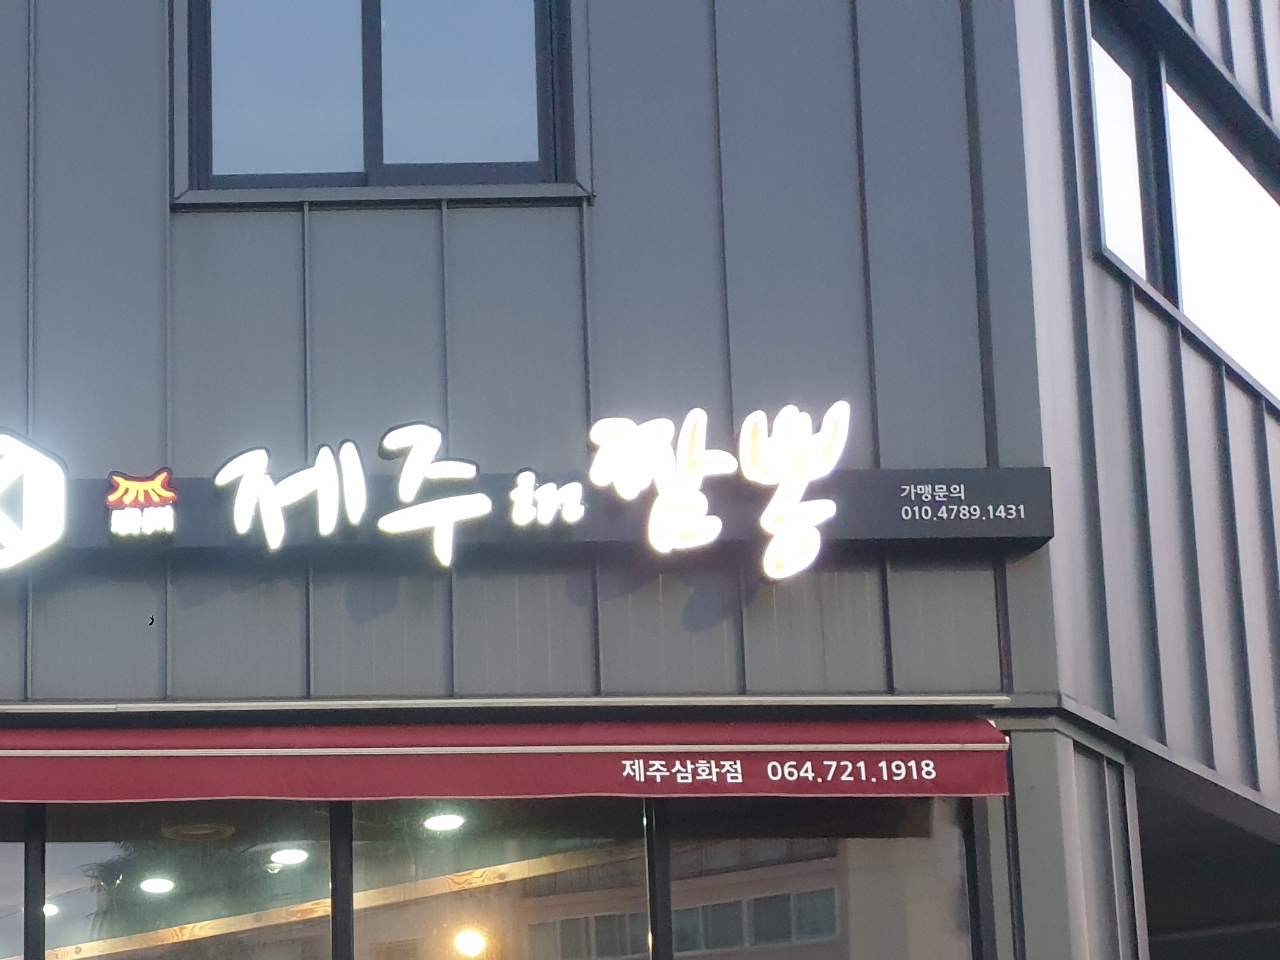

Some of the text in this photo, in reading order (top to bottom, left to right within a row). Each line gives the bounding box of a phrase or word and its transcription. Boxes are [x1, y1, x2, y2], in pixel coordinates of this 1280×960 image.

[900, 483, 965, 502] 가맹문의
[901, 504, 1025, 521] 010.4789.1431
[622, 758, 937, 784] 제주삼화점 064.721.1918
